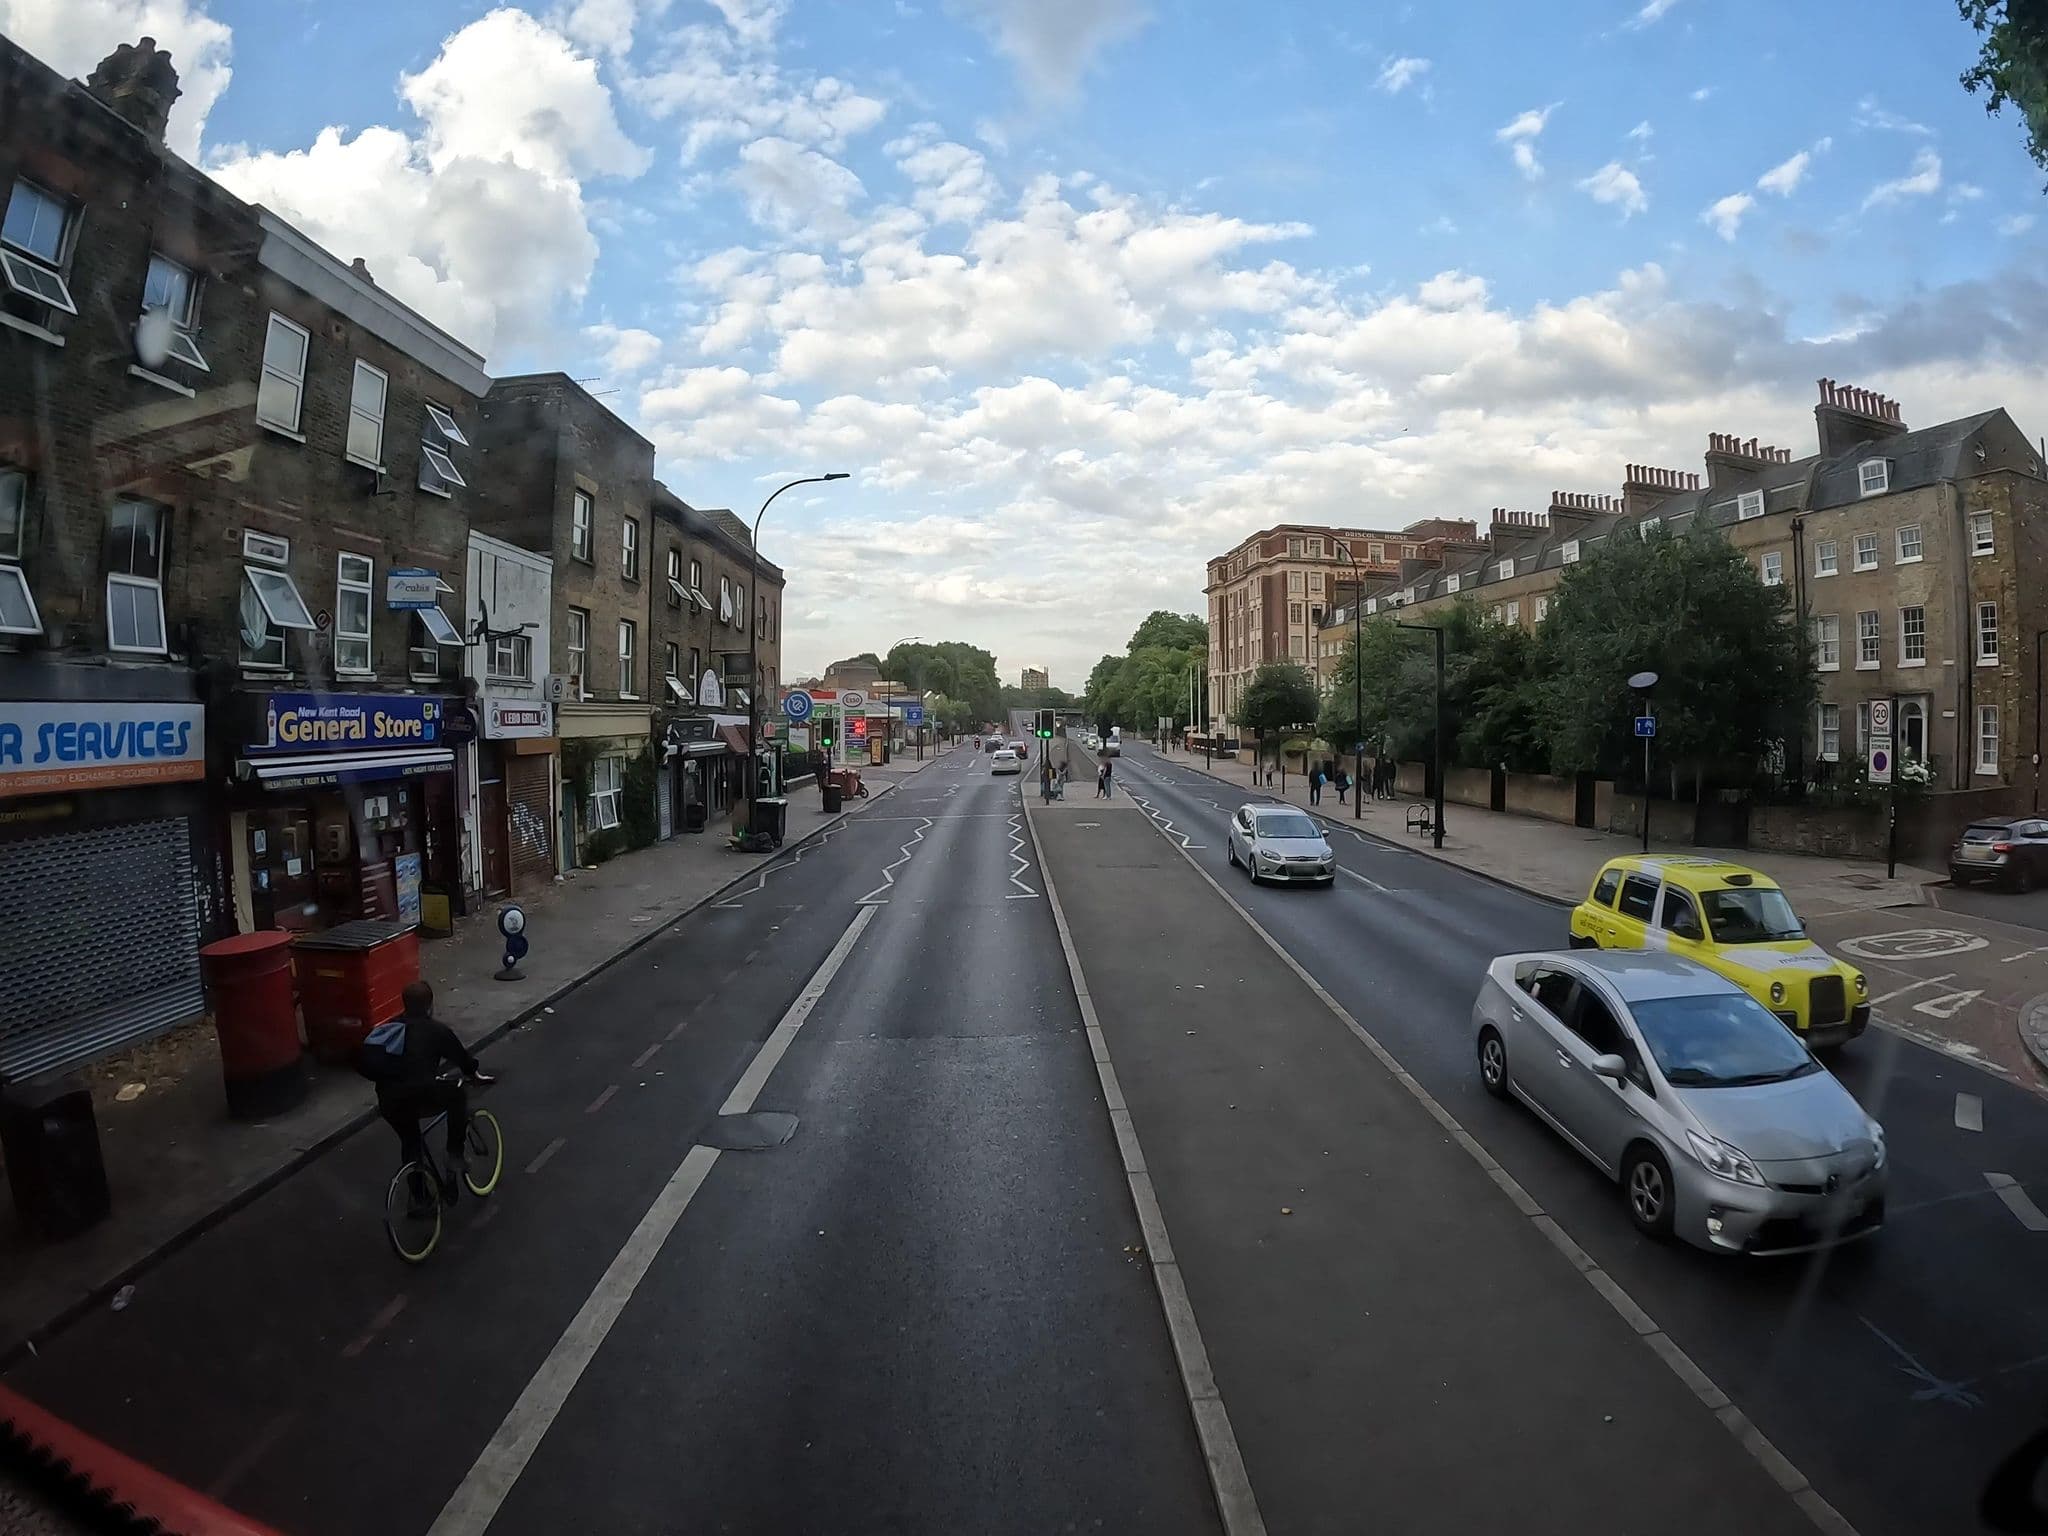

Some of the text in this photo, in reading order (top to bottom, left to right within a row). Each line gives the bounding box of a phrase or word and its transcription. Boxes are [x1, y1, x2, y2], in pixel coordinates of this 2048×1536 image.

[846, 695, 859, 704] Esso
[298, 706, 361, 718] New Kent Road
[1875, 709, 1887, 718] 20
[279, 711, 366, 742] General
[374, 711, 422, 738] Store
[34, 721, 191, 763] SERVICES
[69, 770, 115, 783] EXCHANGE
